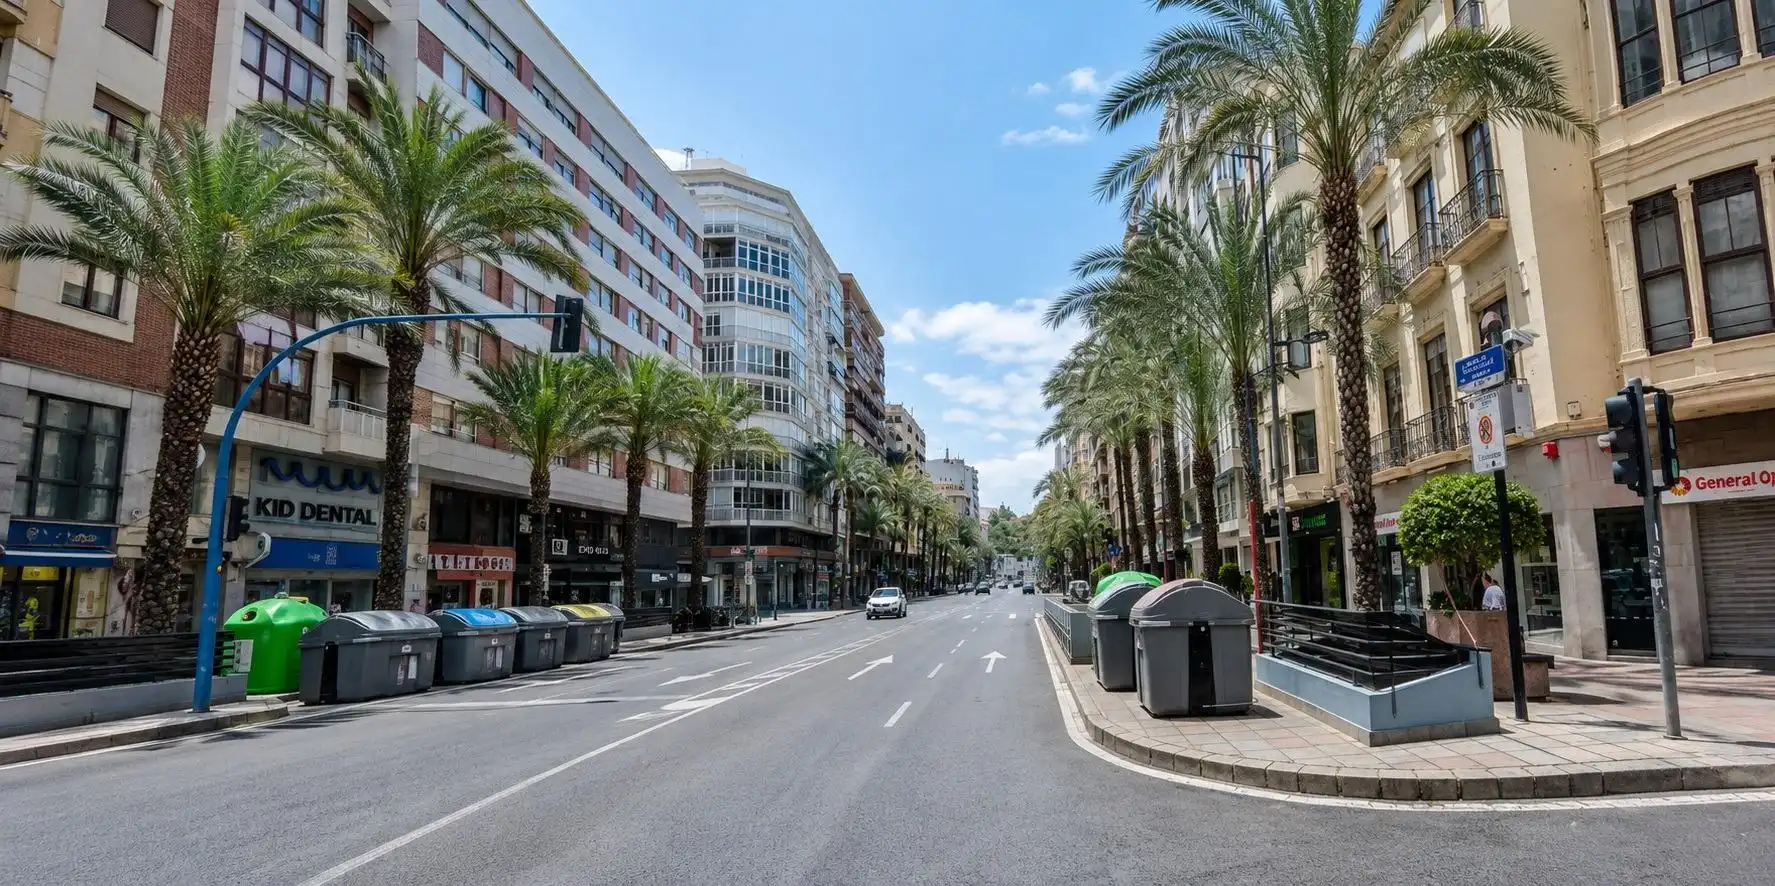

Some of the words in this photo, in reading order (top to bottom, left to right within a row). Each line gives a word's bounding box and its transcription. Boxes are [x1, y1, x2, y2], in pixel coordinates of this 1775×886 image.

[1695, 472, 1757, 490] General
[255, 497, 295, 518] KID
[299, 502, 377, 526] DENTAL
